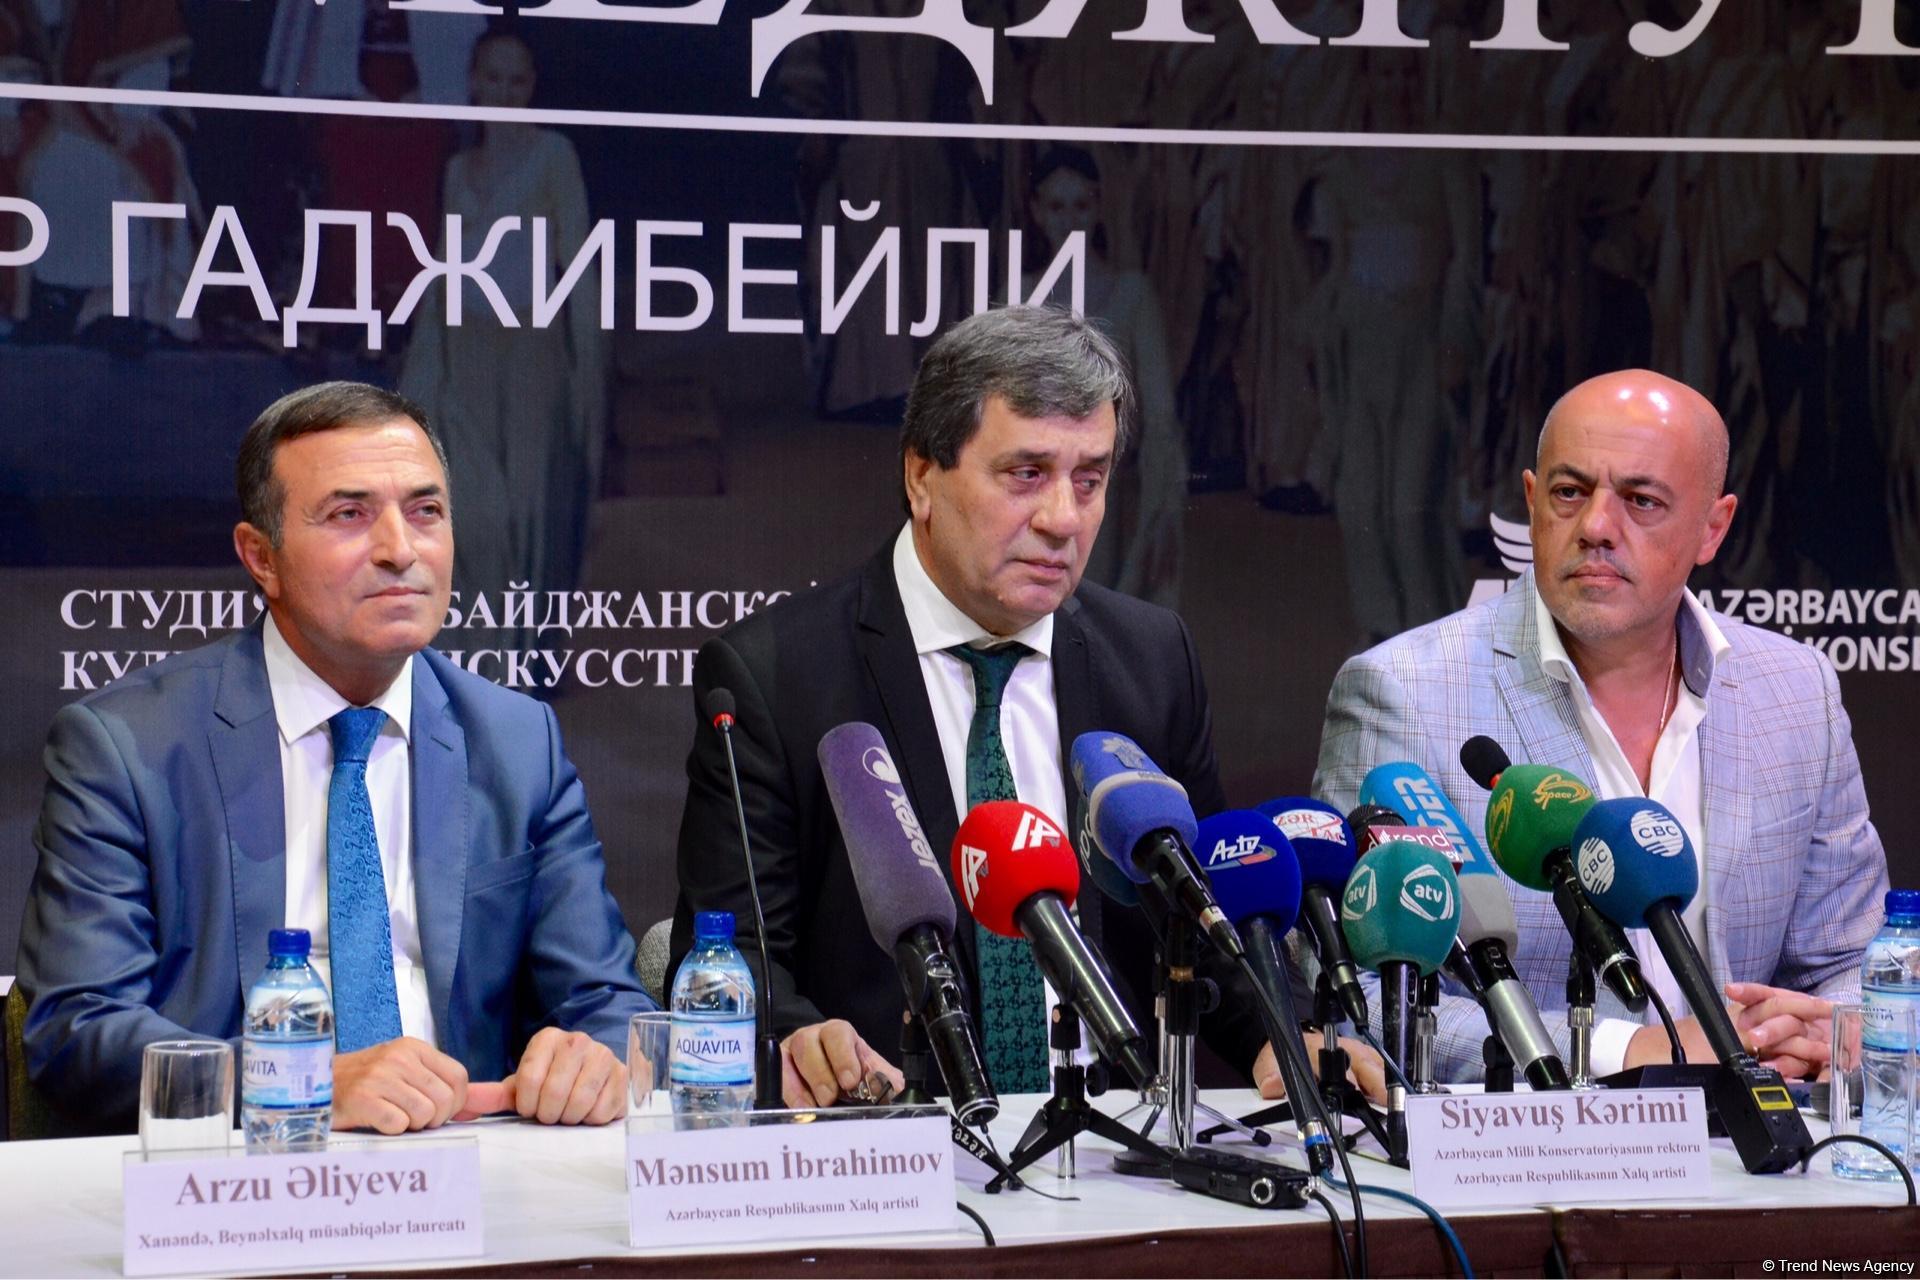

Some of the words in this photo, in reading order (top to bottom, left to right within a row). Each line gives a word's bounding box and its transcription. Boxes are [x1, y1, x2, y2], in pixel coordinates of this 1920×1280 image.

[111, 199, 1086, 350] ГАДЖИБЕЙЛИ
[1638, 825, 1678, 839] CBC
[1582, 849, 1608, 882] CBC
[1348, 884, 1367, 904] atv
[1413, 884, 1443, 904] atv
[676, 1038, 742, 1055] AQUAVITA
[1440, 1098, 1565, 1136] Siyavuş
[1575, 1093, 1688, 1126] Kərimi
[1434, 1148, 1503, 1162] Azərbaycan
[1506, 1145, 1535, 1158] Milli
[1538, 1143, 1654, 1158] Konservatoriyasının
[1656, 1142, 1701, 1154] rektoru
[634, 1157, 770, 1188] Mənsum
[780, 1144, 944, 1181] İbrahimov
[1454, 1172, 1523, 1187] Azərbaycan
[1526, 1169, 1619, 1184] Respublikasının
[1621, 1167, 1650, 1182] Xalq
[1652, 1166, 1687, 1179] artisti
[174, 1171, 273, 1206] Arzu
[286, 1162, 430, 1206] Əliyeva
[665, 1207, 742, 1222] Azərbaycan
[744, 1200, 846, 1219] Respublikasının
[849, 1198, 880, 1213] Xalq
[882, 1196, 920, 1211] artisti
[137, 1230, 214, 1250] Xanəndə,
[218, 1225, 305, 1247] Beynəlxalq
[308, 1221, 403, 1242] müsabiqələr
[406, 1218, 467, 1235] laureatı
